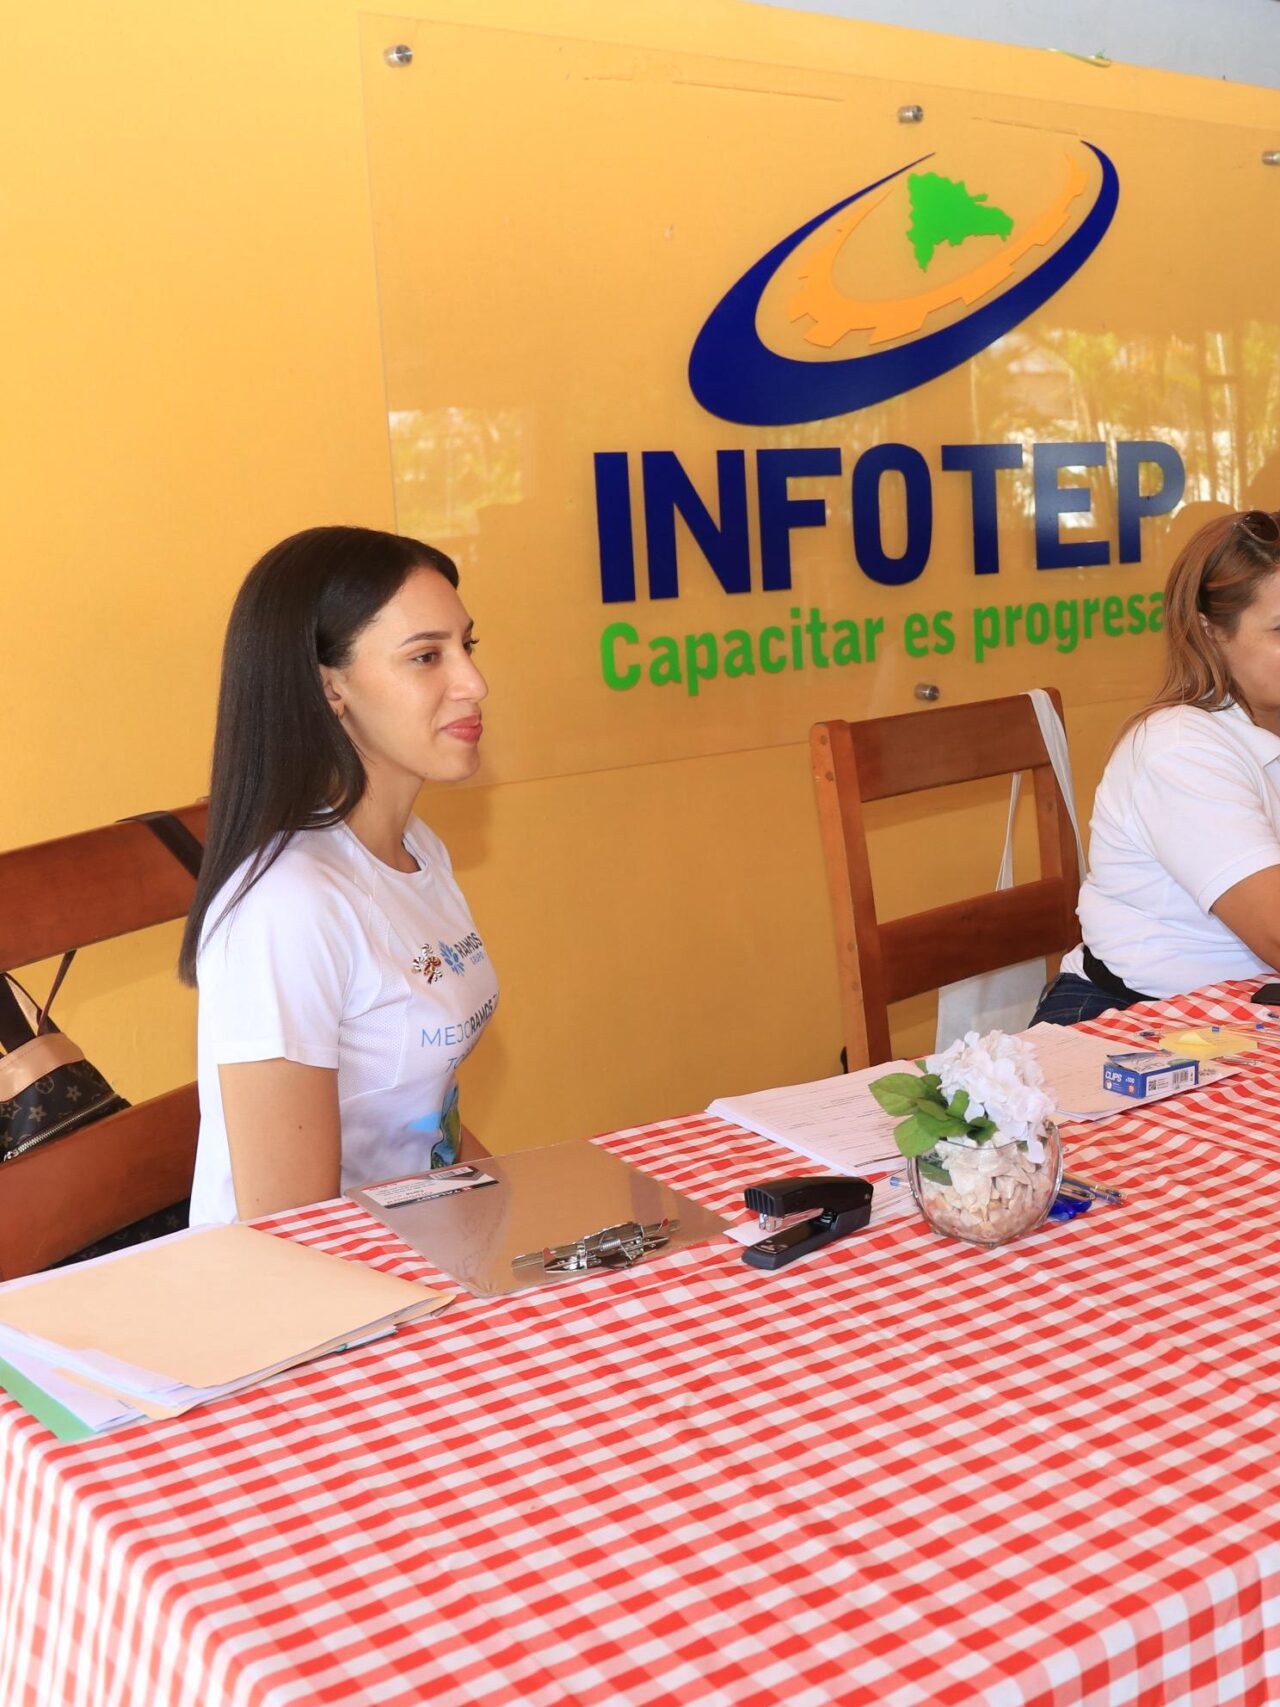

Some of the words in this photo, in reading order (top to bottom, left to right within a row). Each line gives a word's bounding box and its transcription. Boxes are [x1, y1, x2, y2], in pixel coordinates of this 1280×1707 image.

[594, 441, 1186, 603] INFOTEP
[601, 607, 884, 696] Capacitar
[904, 609, 955, 656] es
[974, 591, 1166, 663] progresa
[453, 932, 484, 959] RAMOS
